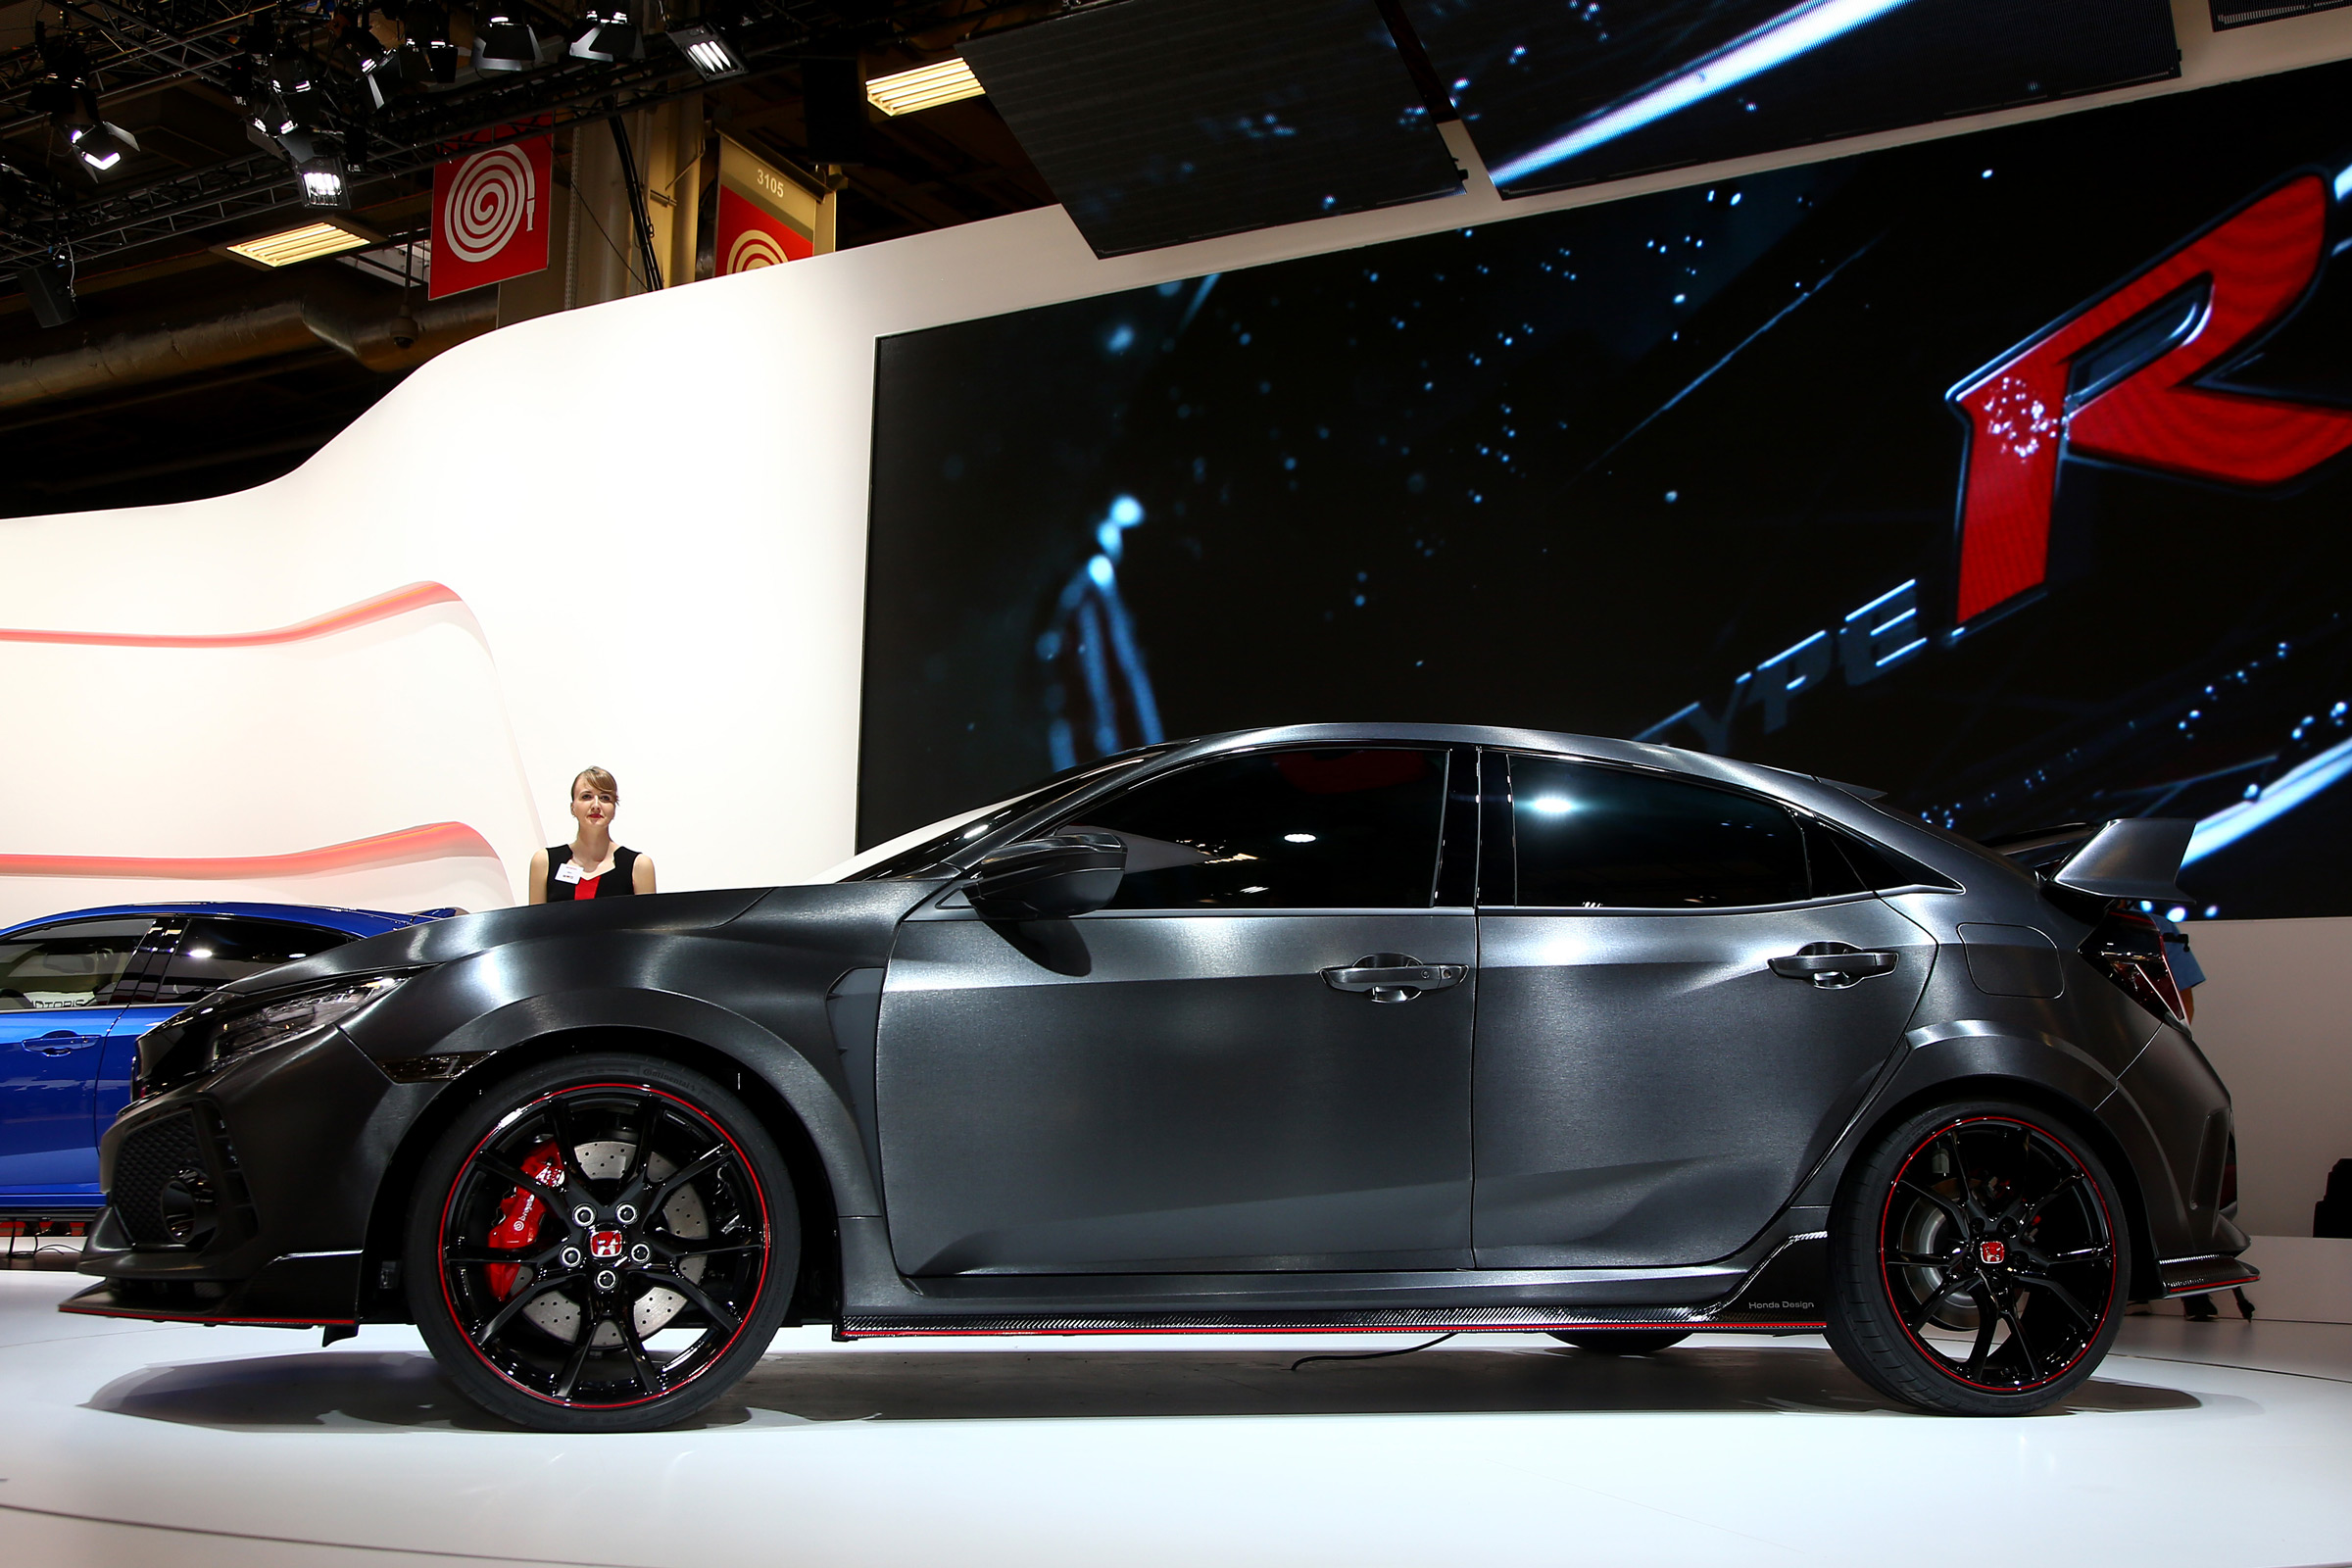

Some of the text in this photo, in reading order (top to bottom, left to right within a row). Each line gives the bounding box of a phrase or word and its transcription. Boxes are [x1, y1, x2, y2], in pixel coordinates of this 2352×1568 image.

[757, 168, 784, 198] 3105
[1948, 168, 2352, 627] R
[643, 1068, 690, 1090] Continental
[1782, 1300, 1815, 1309] Design
